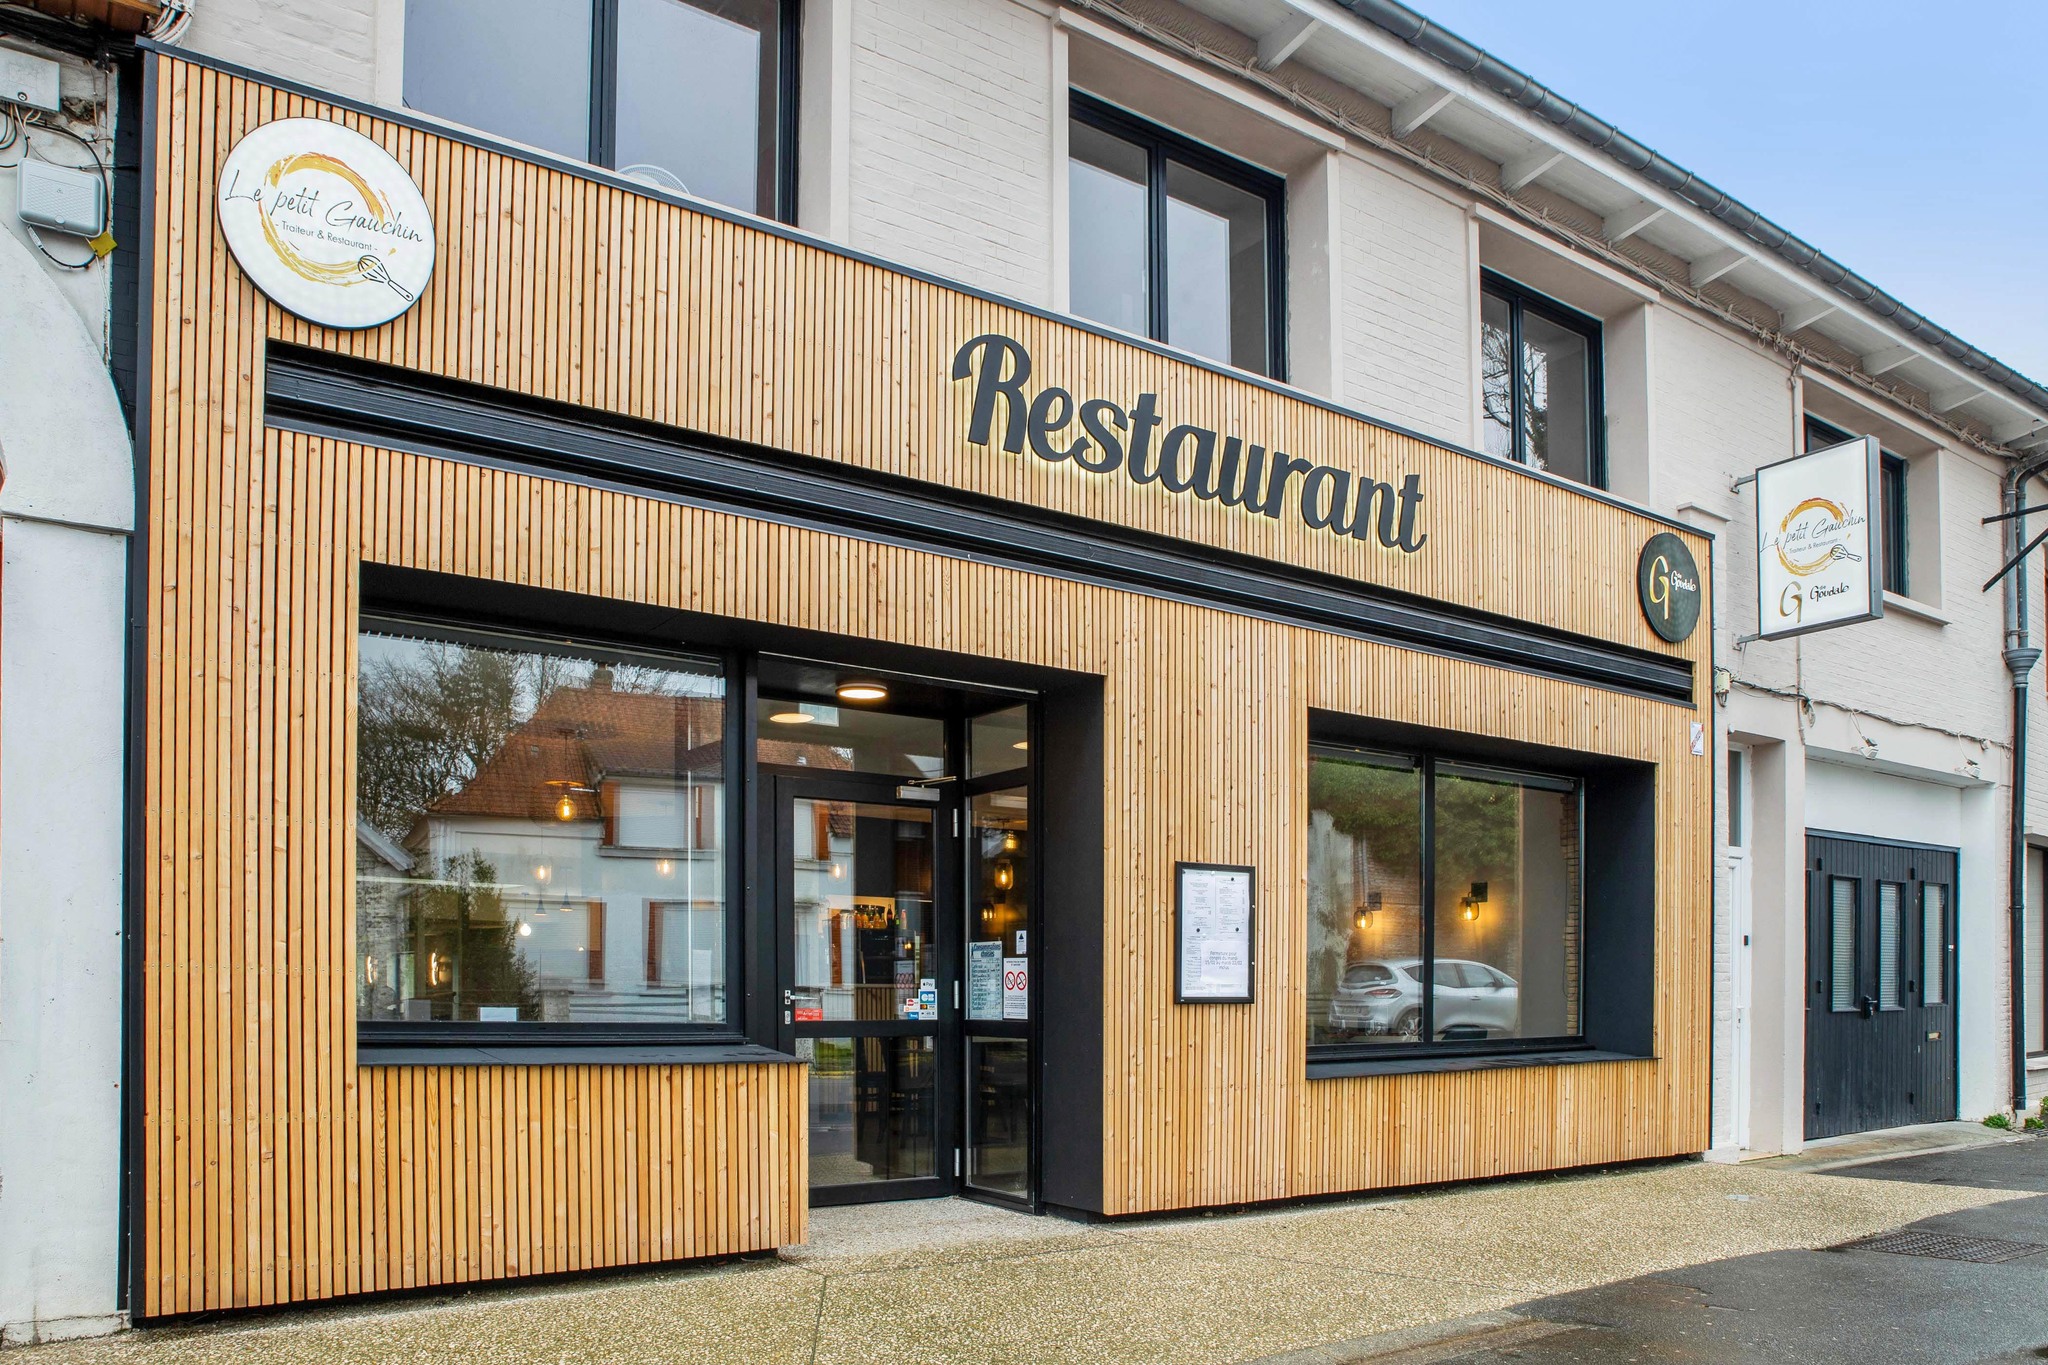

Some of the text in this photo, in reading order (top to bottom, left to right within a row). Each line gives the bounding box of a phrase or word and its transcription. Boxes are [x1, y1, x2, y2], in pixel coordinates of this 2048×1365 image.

[224, 168, 422, 242] Le petit Gauchin
[281, 220, 372, 251] Traiteur & Restaurant
[951, 333, 1428, 553] Restaurant
[1759, 509, 1866, 553] Le petit Gauchin
[1789, 546, 1807, 554] Traiteur
[1813, 538, 1838, 549] Restaurant
[1649, 555, 1669, 620] G
[1779, 581, 1802, 624] G
[1809, 582, 1850, 603] Goudale
